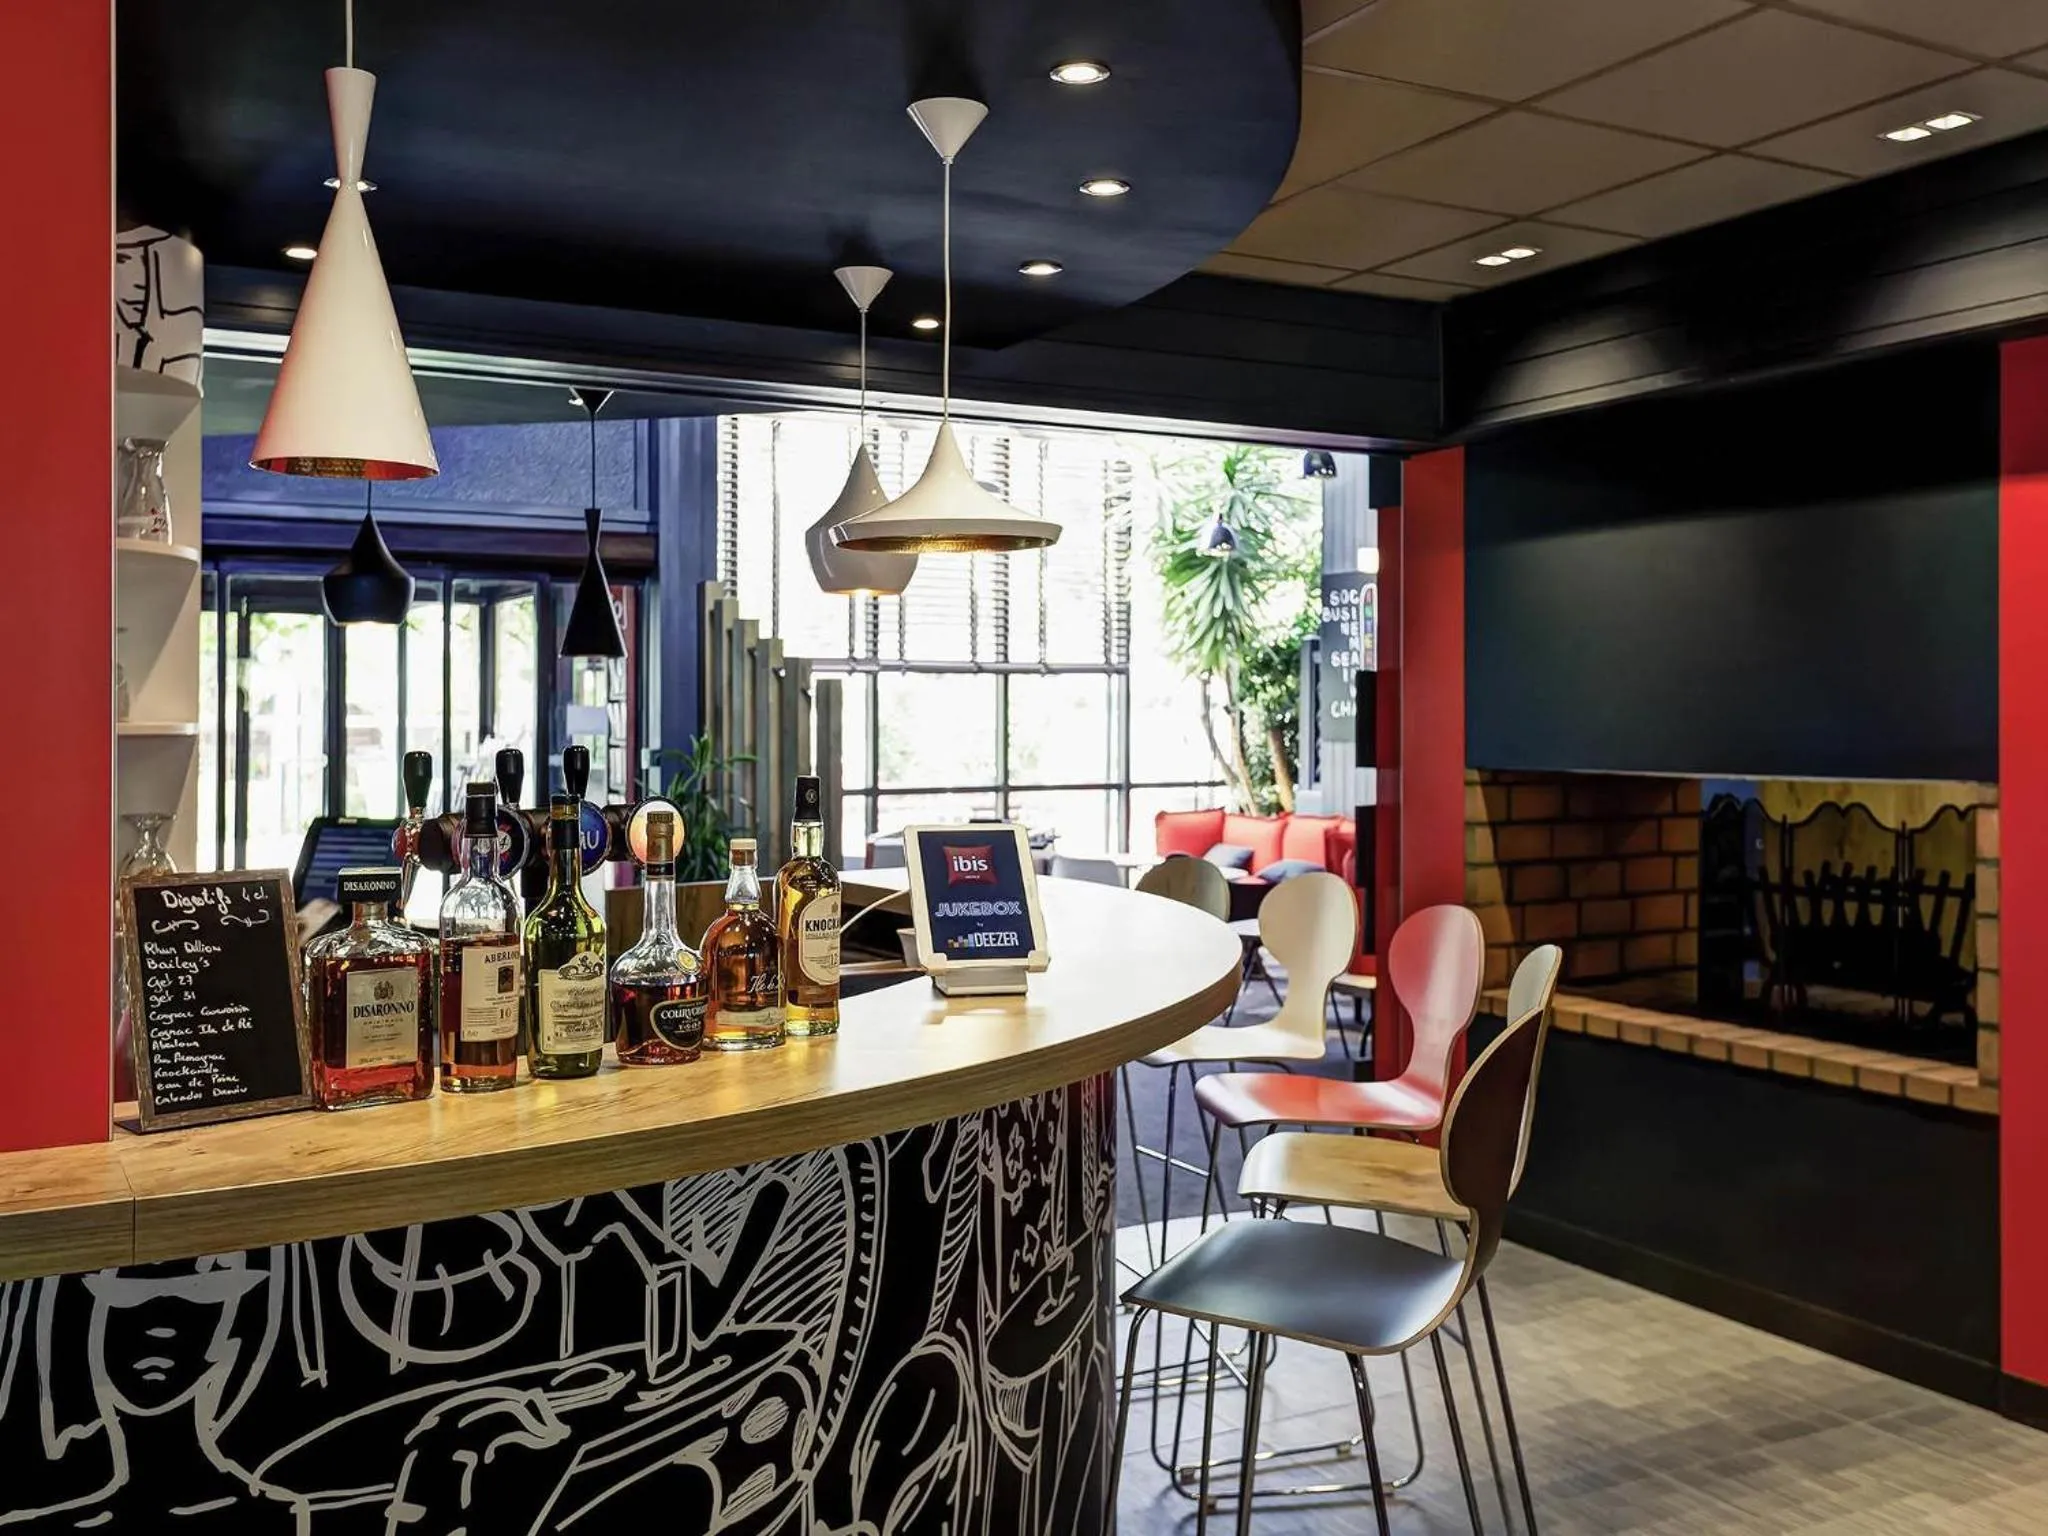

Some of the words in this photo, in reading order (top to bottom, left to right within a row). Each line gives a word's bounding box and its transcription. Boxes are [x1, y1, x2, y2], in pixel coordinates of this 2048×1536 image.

[952, 856, 988, 872] ibis
[343, 880, 397, 892] DISARONNO
[935, 900, 1022, 917] JUKEBOX
[974, 931, 1019, 948] DEEZER
[146, 956, 211, 974] Bailey's
[178, 974, 193, 985] 27
[183, 990, 196, 1001] 31
[353, 1000, 416, 1018] DISARONNO
[499, 1007, 512, 1019] 10
[149, 1010, 194, 1025] Cognac
[150, 1027, 193, 1040] Cognac
